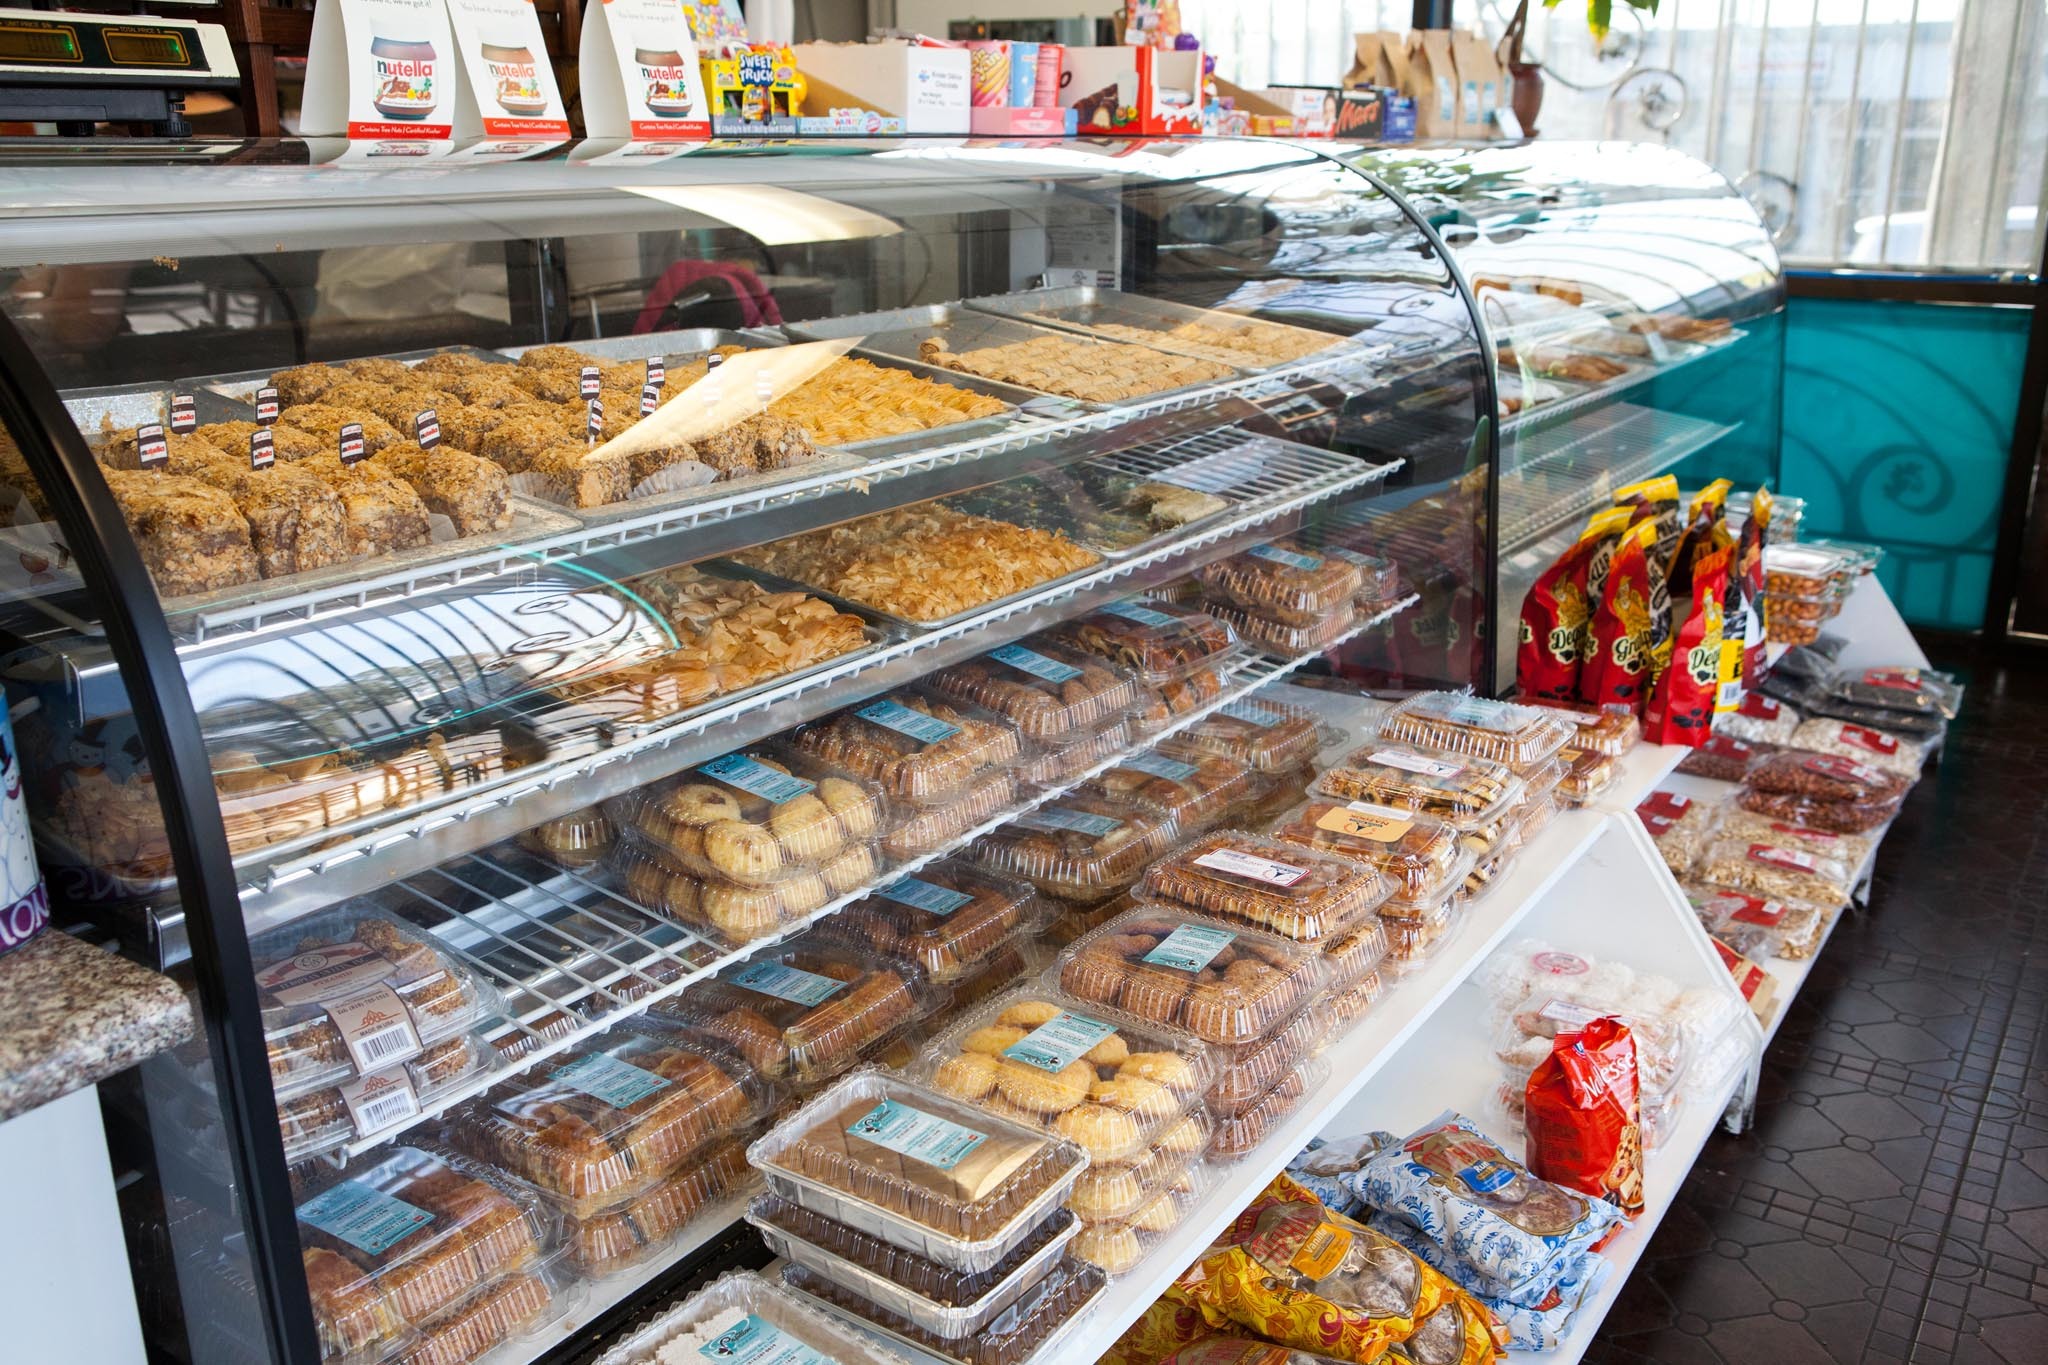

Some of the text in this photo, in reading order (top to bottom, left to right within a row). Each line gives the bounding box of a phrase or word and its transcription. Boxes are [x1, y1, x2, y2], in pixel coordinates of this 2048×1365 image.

[377, 60, 433, 77] nutella
[740, 54, 773, 69] SWEET
[489, 63, 536, 78] nutella
[641, 66, 684, 81] nutella
[739, 68, 774, 83] TRUCK
[1336, 100, 1381, 132] Mars
[360, 1028, 376, 1037] MADE
[384, 1020, 395, 1029] USA
[385, 1085, 396, 1095] USA
